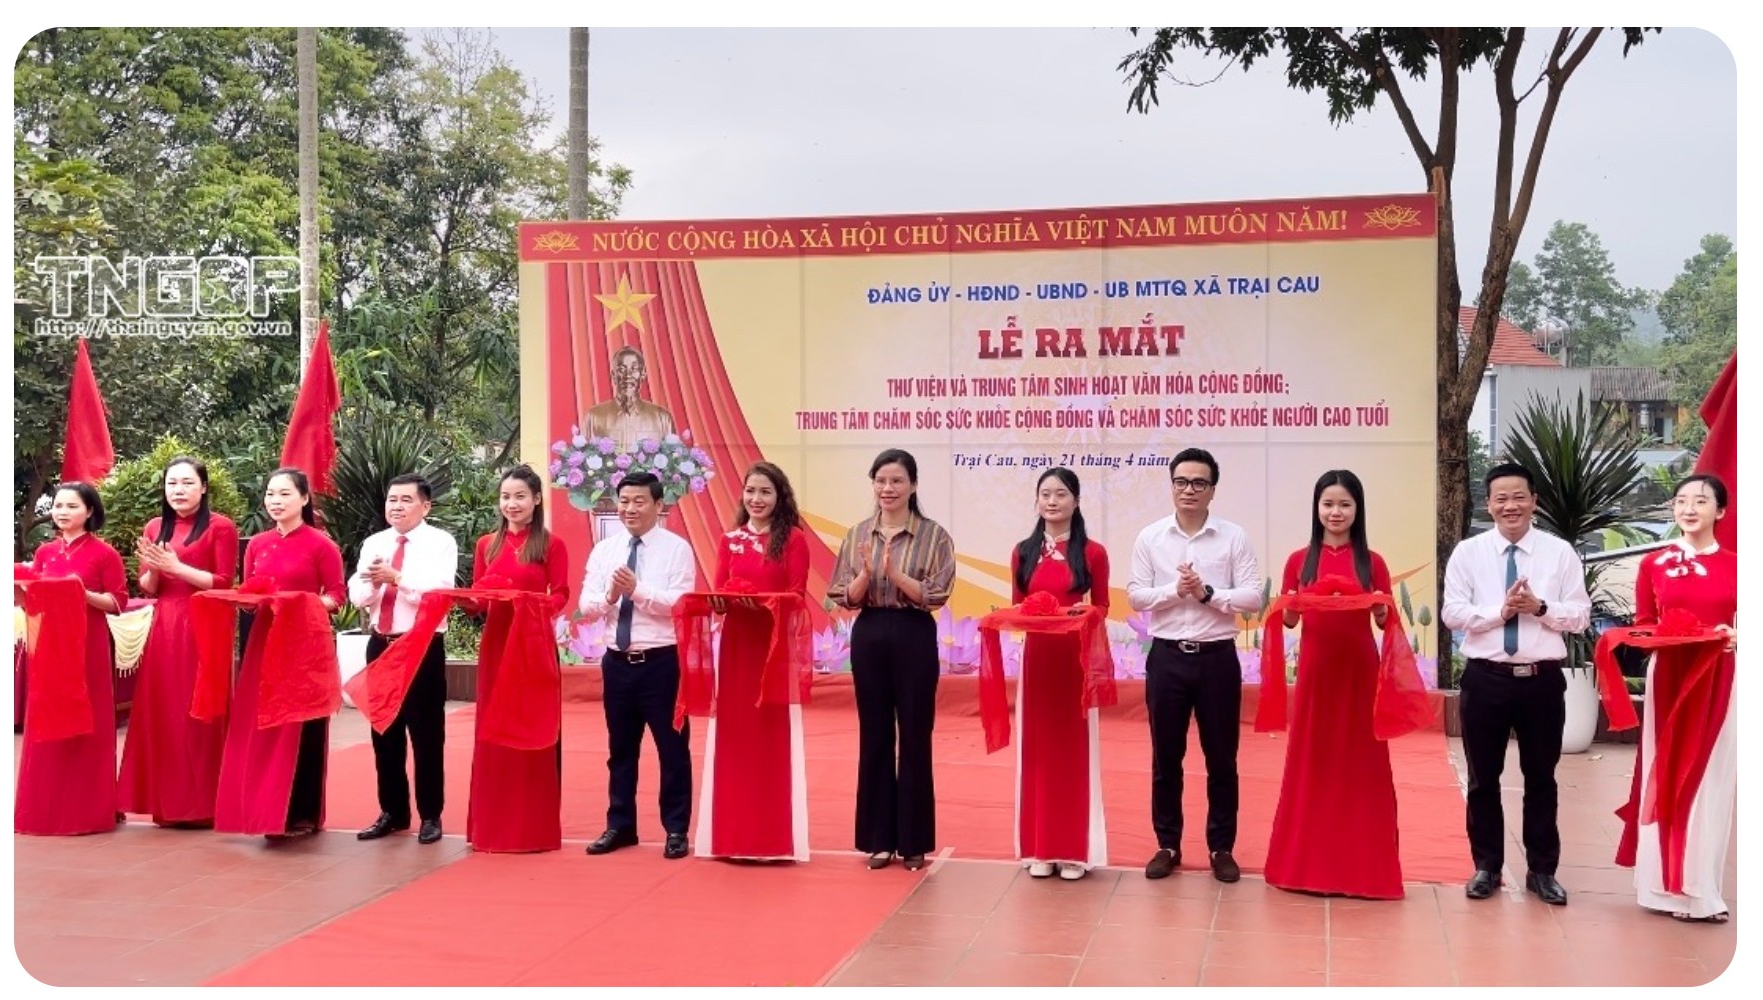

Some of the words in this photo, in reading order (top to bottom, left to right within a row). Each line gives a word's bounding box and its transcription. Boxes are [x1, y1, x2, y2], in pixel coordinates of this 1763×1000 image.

[592, 227, 659, 251] NƯỚC
[667, 225, 736, 255] CỘNG
[743, 224, 794, 249] HÒA
[800, 224, 833, 248] XÃ
[841, 221, 887, 252] HỘI
[894, 216, 947, 246] CHỦ
[956, 217, 1040, 243] NGHĨA
[1046, 213, 1108, 244] VIỆT
[1116, 216, 1176, 238] NAM
[1184, 208, 1267, 236] MUÔN
[1276, 206, 1348, 232] NĂM!
[867, 283, 922, 303] ĐẢNG
[928, 281, 950, 302] ỦY
[968, 285, 1020, 301] HĐND
[1037, 283, 1087, 300] UBND
[1105, 281, 1129, 298] UB
[1136, 279, 1187, 297] MTTQ
[1193, 275, 1222, 295] XÃ
[1227, 277, 1269, 299] TRẠI
[1277, 276, 1319, 293] CAU
[978, 316, 1023, 359] LỄ
[1035, 328, 1087, 358] RA
[1098, 313, 1185, 357] MẮT
[887, 377, 913, 398] THƯ
[916, 374, 947, 401] VIỆN
[950, 373, 967, 397] VÀ
[971, 377, 1016, 397] TRUNG
[1020, 373, 1049, 396] TÂM
[1054, 376, 1088, 395] SINH
[1092, 375, 1127, 399] HOẠT
[1132, 372, 1160, 395] VĂN
[1166, 371, 1194, 394] HÓA
[1198, 370, 1238, 398] CỘNG
[796, 411, 837, 430] TRUNG
[841, 408, 869, 430] TÂM
[873, 407, 911, 430] CHĂM
[916, 407, 942, 430] SÓC
[946, 407, 972, 429] SỨC
[976, 404, 1011, 429] KHỎE
[1015, 406, 1052, 432] CỘNG
[1056, 402, 1093, 429] ĐỒNG
[1098, 404, 1115, 428] VÀ
[1120, 405, 1161, 428] CHĂM
[1165, 404, 1193, 428] SÓC
[1198, 404, 1226, 427] SỨC
[1230, 401, 1268, 427] KHỎE
[1273, 402, 1318, 427] NGƯỜI
[1323, 406, 1351, 427] CAO
[1356, 399, 1389, 427] TUỔI
[953, 453, 982, 470] Trại
[1059, 453, 1075, 466] 21
[1080, 453, 1121, 470] tháng
[1125, 453, 1134, 466] 4
[1138, 453, 1170, 466] năm
